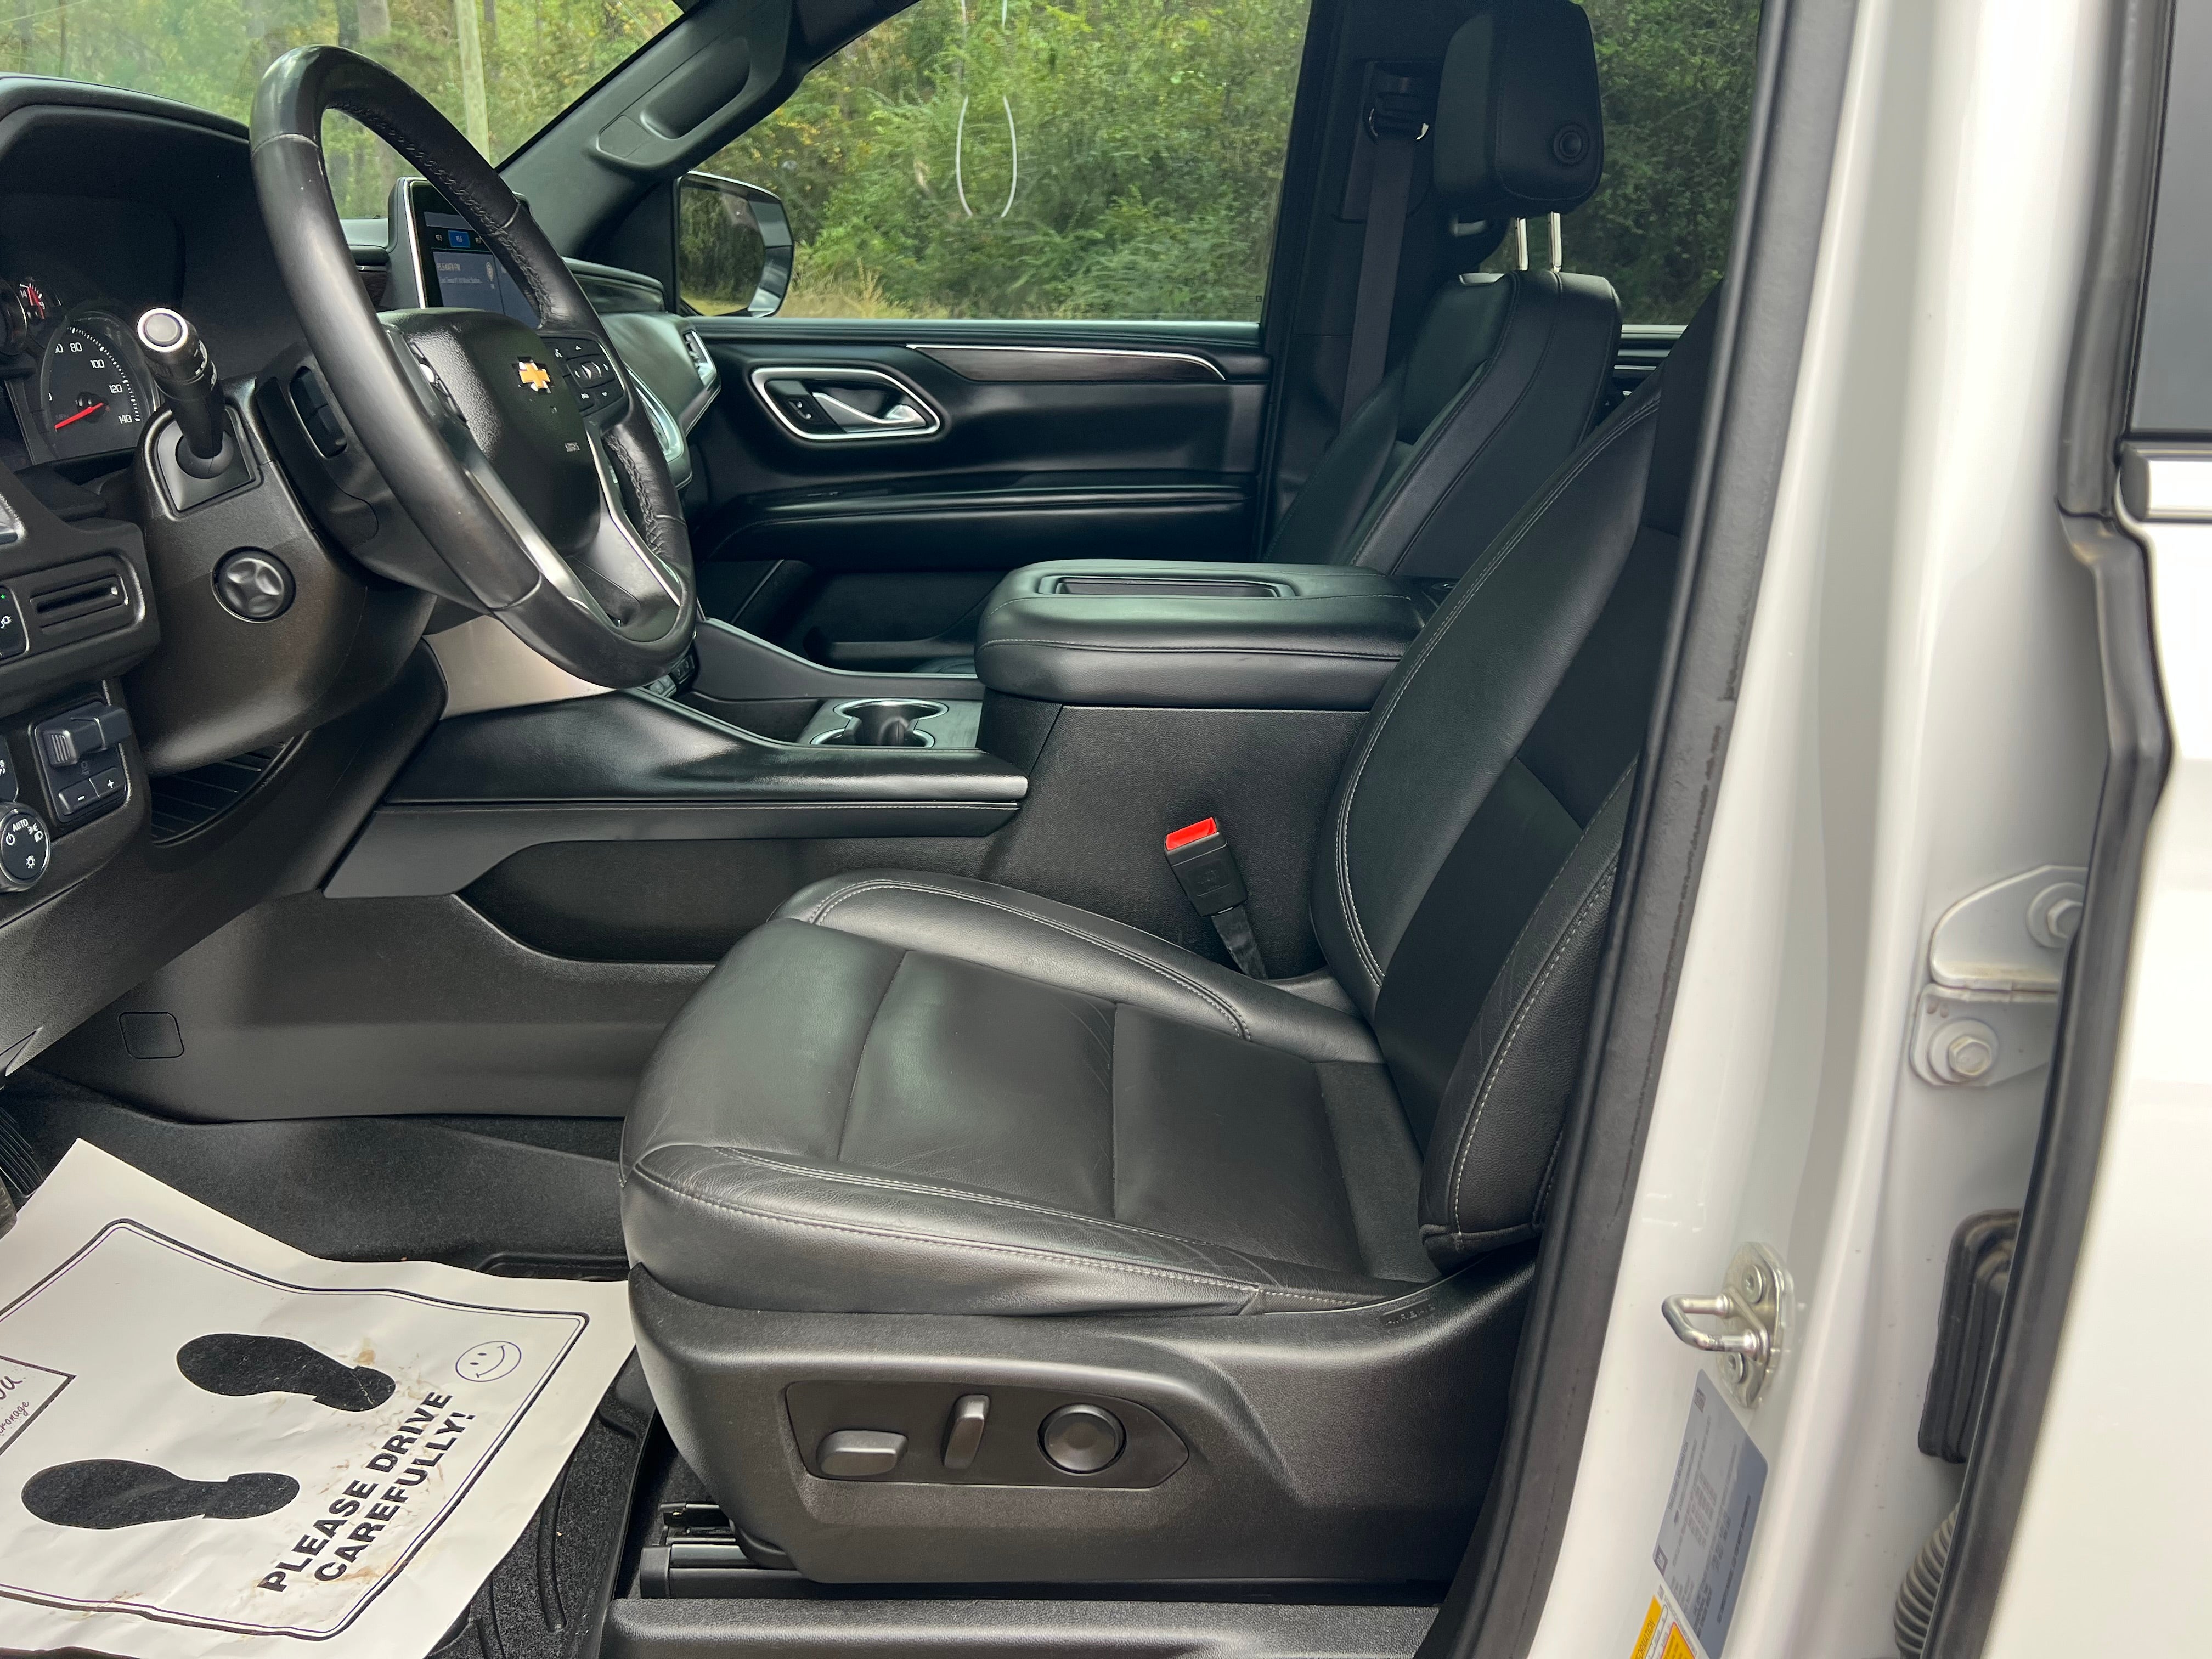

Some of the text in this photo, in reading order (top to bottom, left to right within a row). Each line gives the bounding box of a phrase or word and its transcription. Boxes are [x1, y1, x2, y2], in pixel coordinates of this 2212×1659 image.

[70, 342, 82, 352] 80
[90, 359, 105, 368] 100
[109, 384, 122, 393] 120
[119, 414, 132, 424] 140
[13, 818, 29, 832] AUTO
[257, 1391, 453, 1592] PLEASE DRIVE
[314, 1412, 476, 1581] CAREFULLY!
